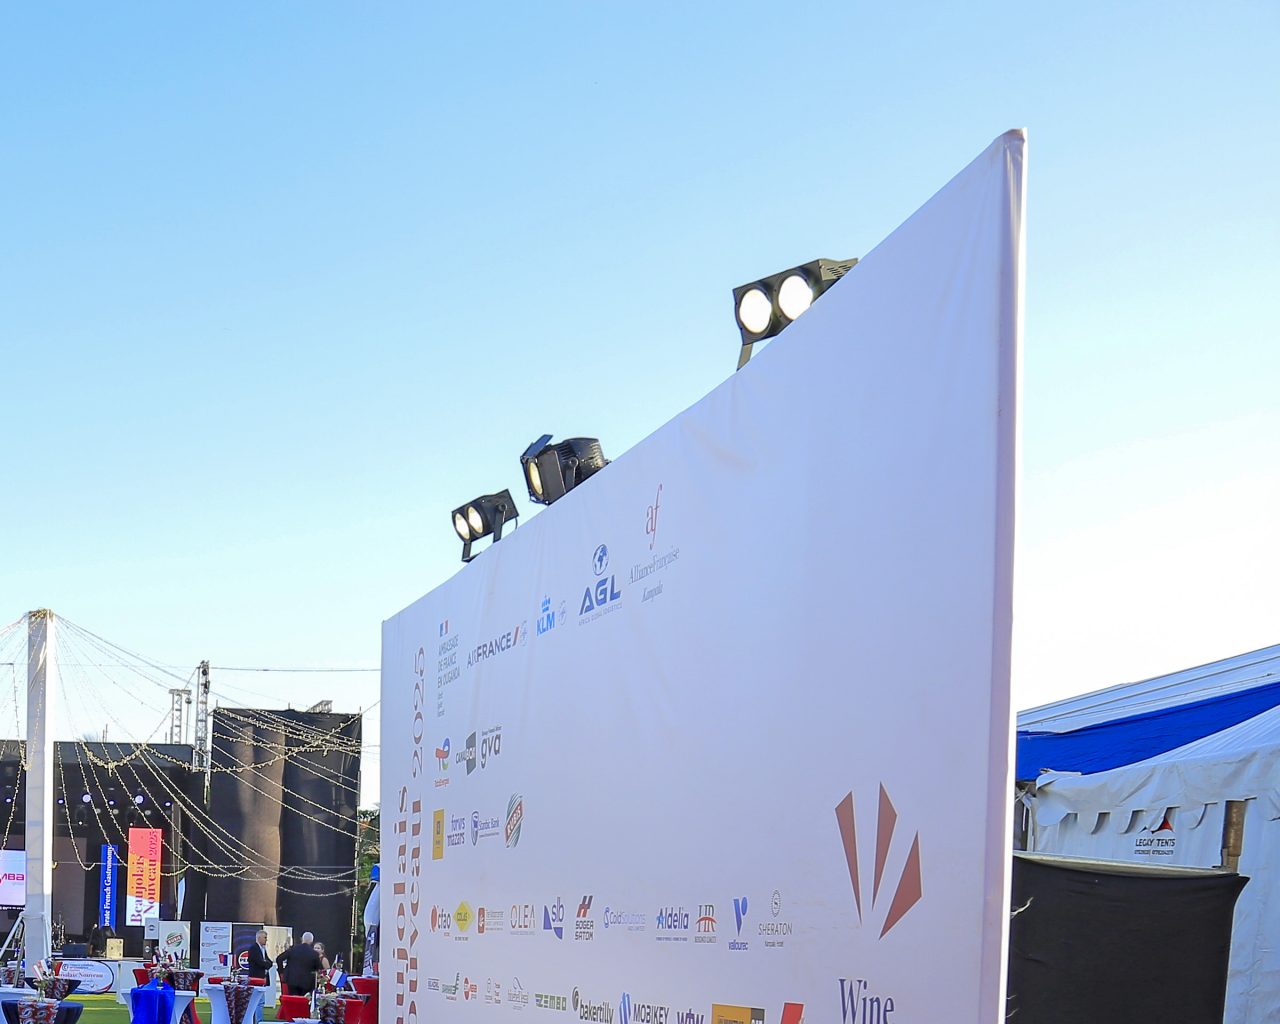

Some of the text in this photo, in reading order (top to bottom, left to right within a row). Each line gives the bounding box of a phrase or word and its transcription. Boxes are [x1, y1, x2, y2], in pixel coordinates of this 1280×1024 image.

[579, 574, 622, 616] AGL
[537, 612, 555, 636] KLM
[412, 646, 425, 778] 2025
[481, 733, 501, 769] gva
[1156, 838, 1176, 847] TENTS
[105, 845, 113, 886] Gastronomy
[131, 855, 146, 924] Beaujolais
[143, 859, 156, 914] Nouveau
[438, 909, 451, 929] cfao
[511, 905, 535, 929] OLEA
[551, 897, 564, 923] slb
[656, 906, 689, 930] Aldelia
[575, 920, 594, 930] SOGEA
[575, 931, 594, 941] SATOM
[758, 922, 792, 935] SHERATON
[535, 993, 567, 1011] ZEMBO
